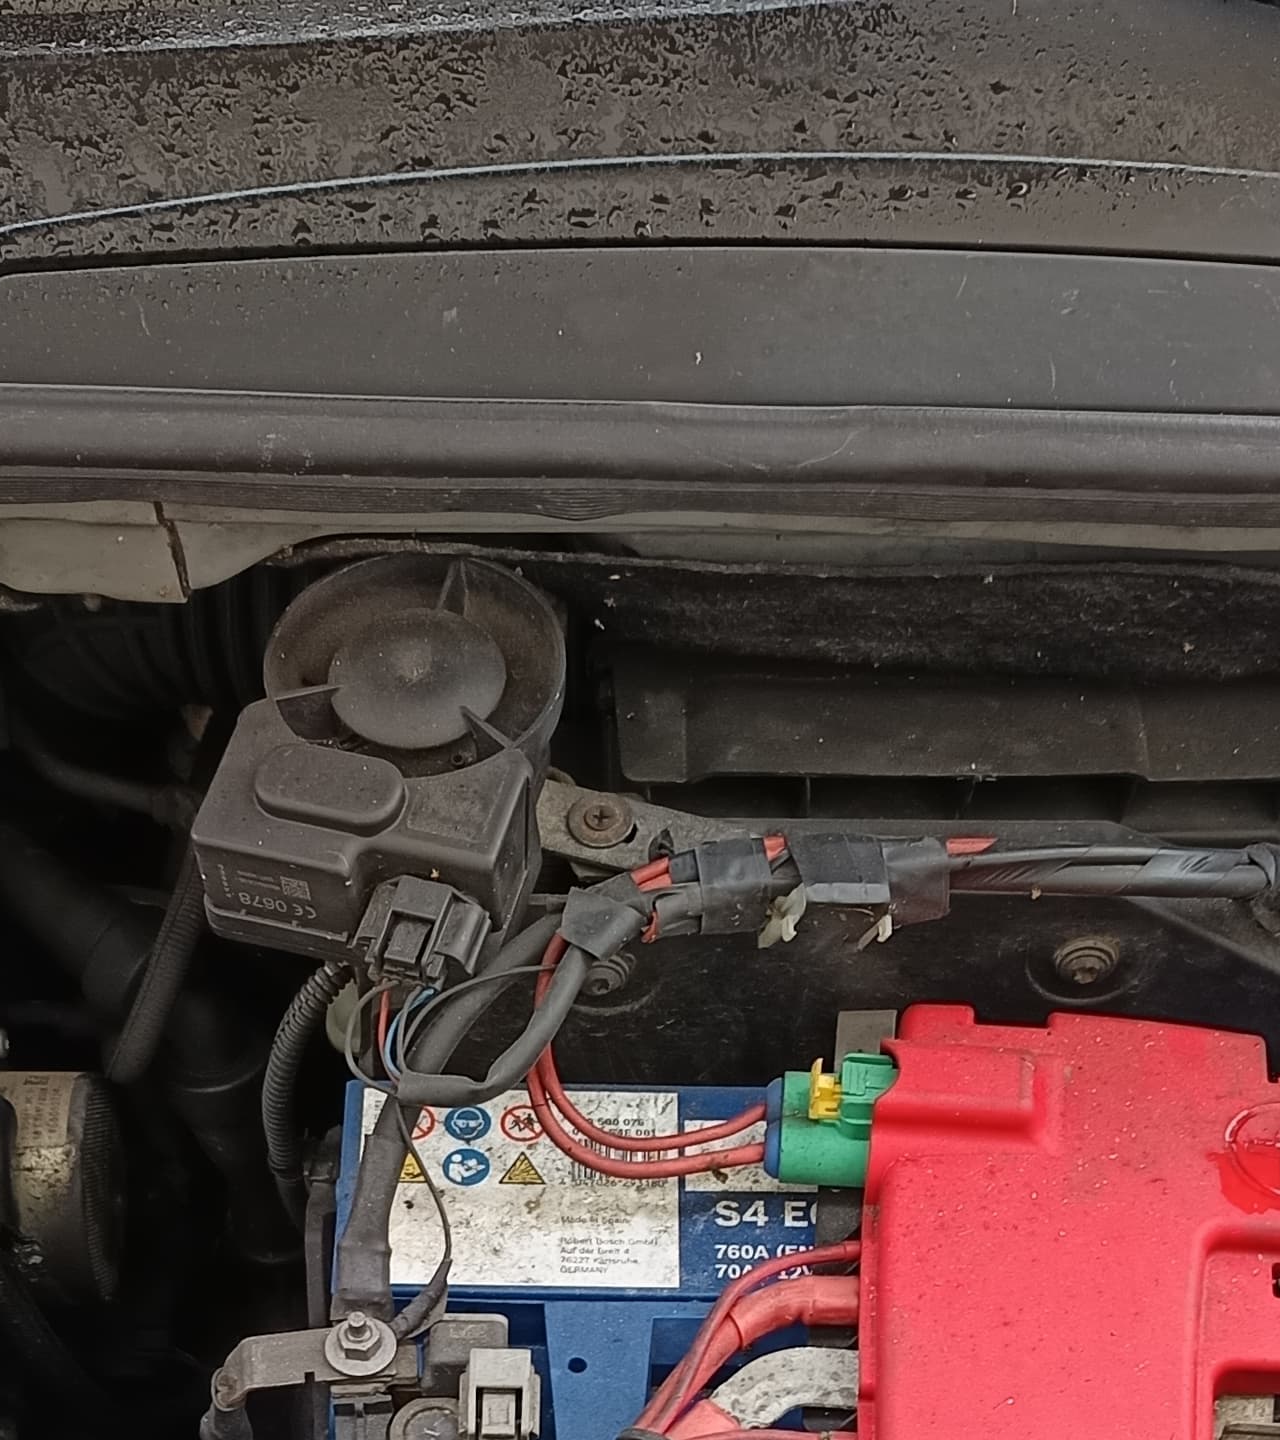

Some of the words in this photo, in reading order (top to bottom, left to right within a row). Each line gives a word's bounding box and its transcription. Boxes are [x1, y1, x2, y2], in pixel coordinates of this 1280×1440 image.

[238, 892, 287, 914] 0678
[714, 1199, 769, 1228] S4
[713, 1244, 770, 1260] 760A
